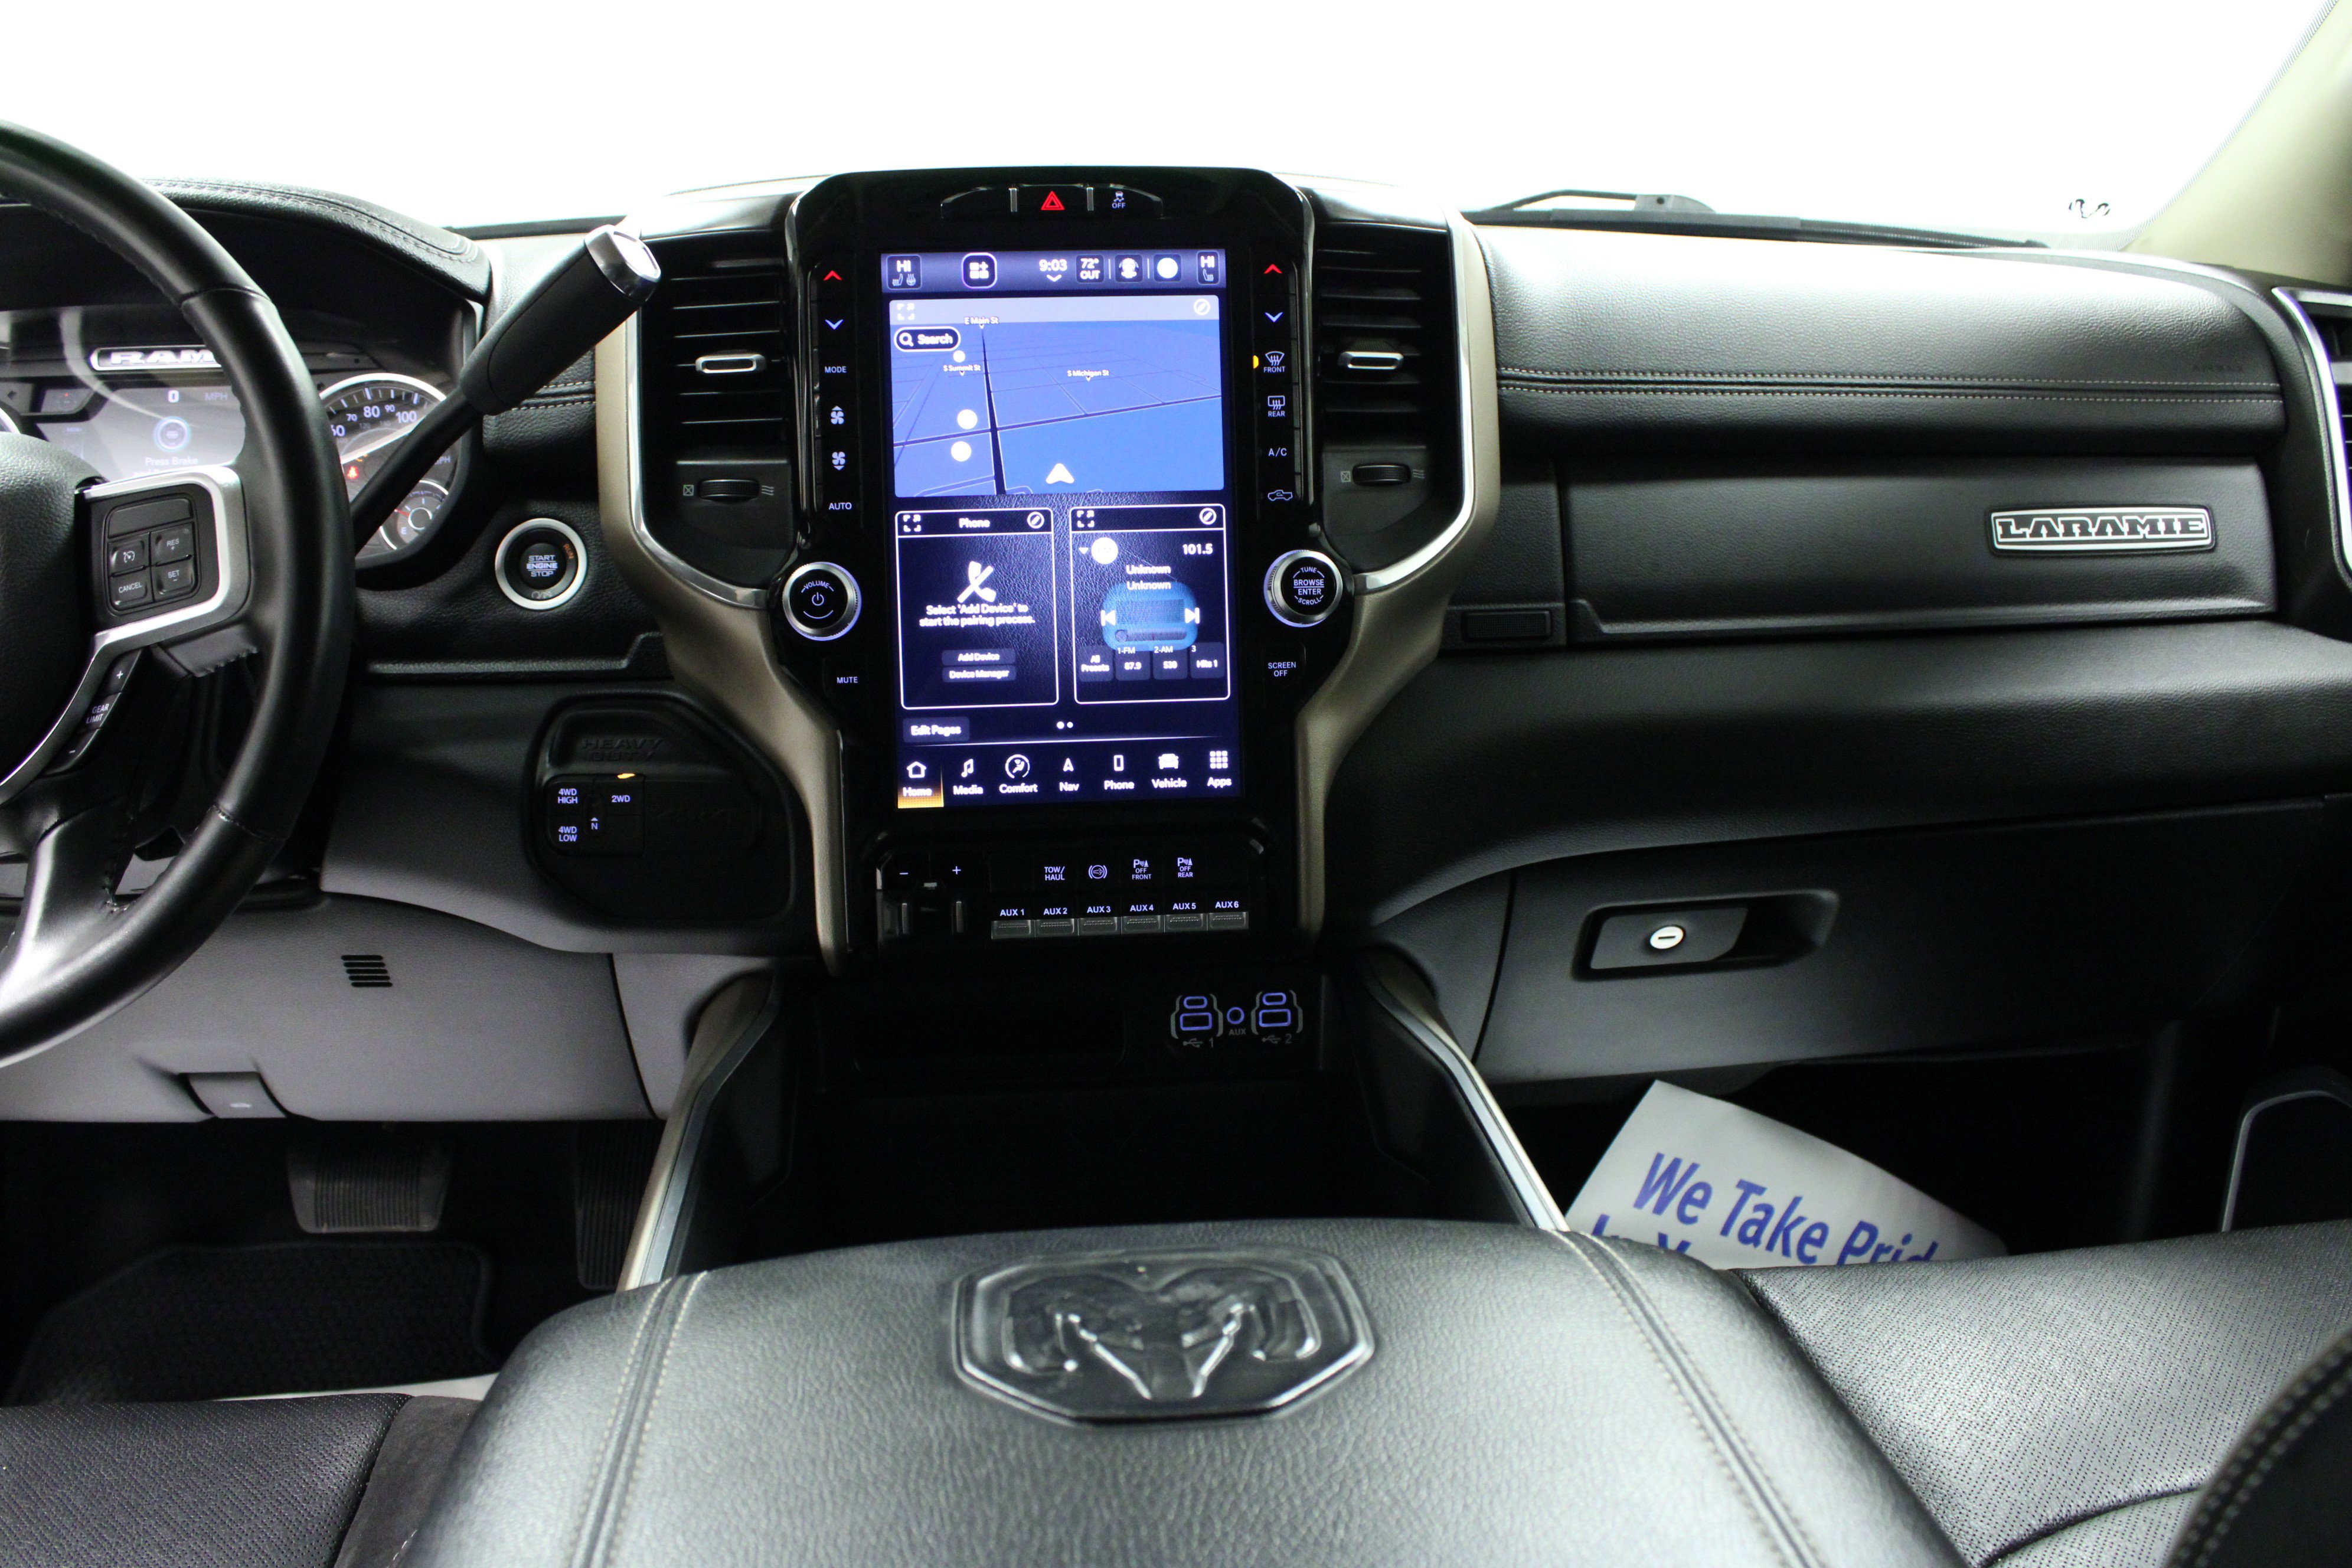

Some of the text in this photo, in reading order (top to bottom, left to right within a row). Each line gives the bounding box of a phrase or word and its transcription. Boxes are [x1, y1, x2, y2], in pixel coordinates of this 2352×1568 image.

[897, 260, 912, 272] HI
[1039, 259, 1067, 272] 9:03
[1201, 256, 1215, 268] HI
[1080, 270, 1100, 279] OUT
[990, 316, 999, 324] St
[917, 333, 953, 345] Search
[110, 349, 215, 365] RAM
[168, 390, 179, 403] 0
[205, 393, 228, 401] MPH
[363, 406, 380, 418] 80
[385, 404, 395, 413] 90
[396, 411, 417, 423] 100
[1269, 447, 1287, 456] A/C
[145, 456, 198, 466] Press Brake
[828, 502, 852, 511] AUTO
[959, 517, 990, 530] Phone
[1997, 515, 2206, 540] LARAMIE
[401, 527, 407, 535] E
[166, 538, 179, 547] RES
[1182, 543, 1213, 555] 101.5
[1126, 564, 1171, 574] Unknown
[168, 570, 179, 579] SET
[119, 582, 142, 593] CANCEL
[803, 580, 830, 589] VOLUME
[1126, 580, 1171, 590] Unknown
[926, 605, 956, 615] Select
[1017, 603, 1028, 613] to
[919, 615, 1035, 628] start the pairing process.
[957, 652, 1000, 661] Add Device
[1090, 655, 1100, 663] All
[1081, 664, 1110, 672] Presets
[1124, 662, 1142, 670] 87.9
[1196, 659, 1218, 668] Hits 1
[949, 669, 1010, 679] Device Manager
[92, 703, 109, 713] GEAR
[86, 714, 104, 724] LIMIT
[910, 724, 962, 737] Edit Pages
[582, 739, 662, 749] HEAVY
[1059, 782, 1079, 792] Nav
[1104, 780, 1135, 790] Phone
[1151, 778, 1187, 788] Vehicle
[1207, 777, 1232, 788] Apps
[903, 786, 933, 797] Home
[953, 784, 984, 795] Media
[999, 783, 1038, 793] Comfort
[1044, 865, 1065, 874] TOW/
[999, 909, 1018, 917] AUX
[1229, 1028, 1246, 1036] AUX
[1209, 1037, 1214, 1048] 1
[1285, 1034, 1292, 1044] 2
[1633, 1152, 1713, 1225] We
[1720, 1179, 1830, 1265] Take
